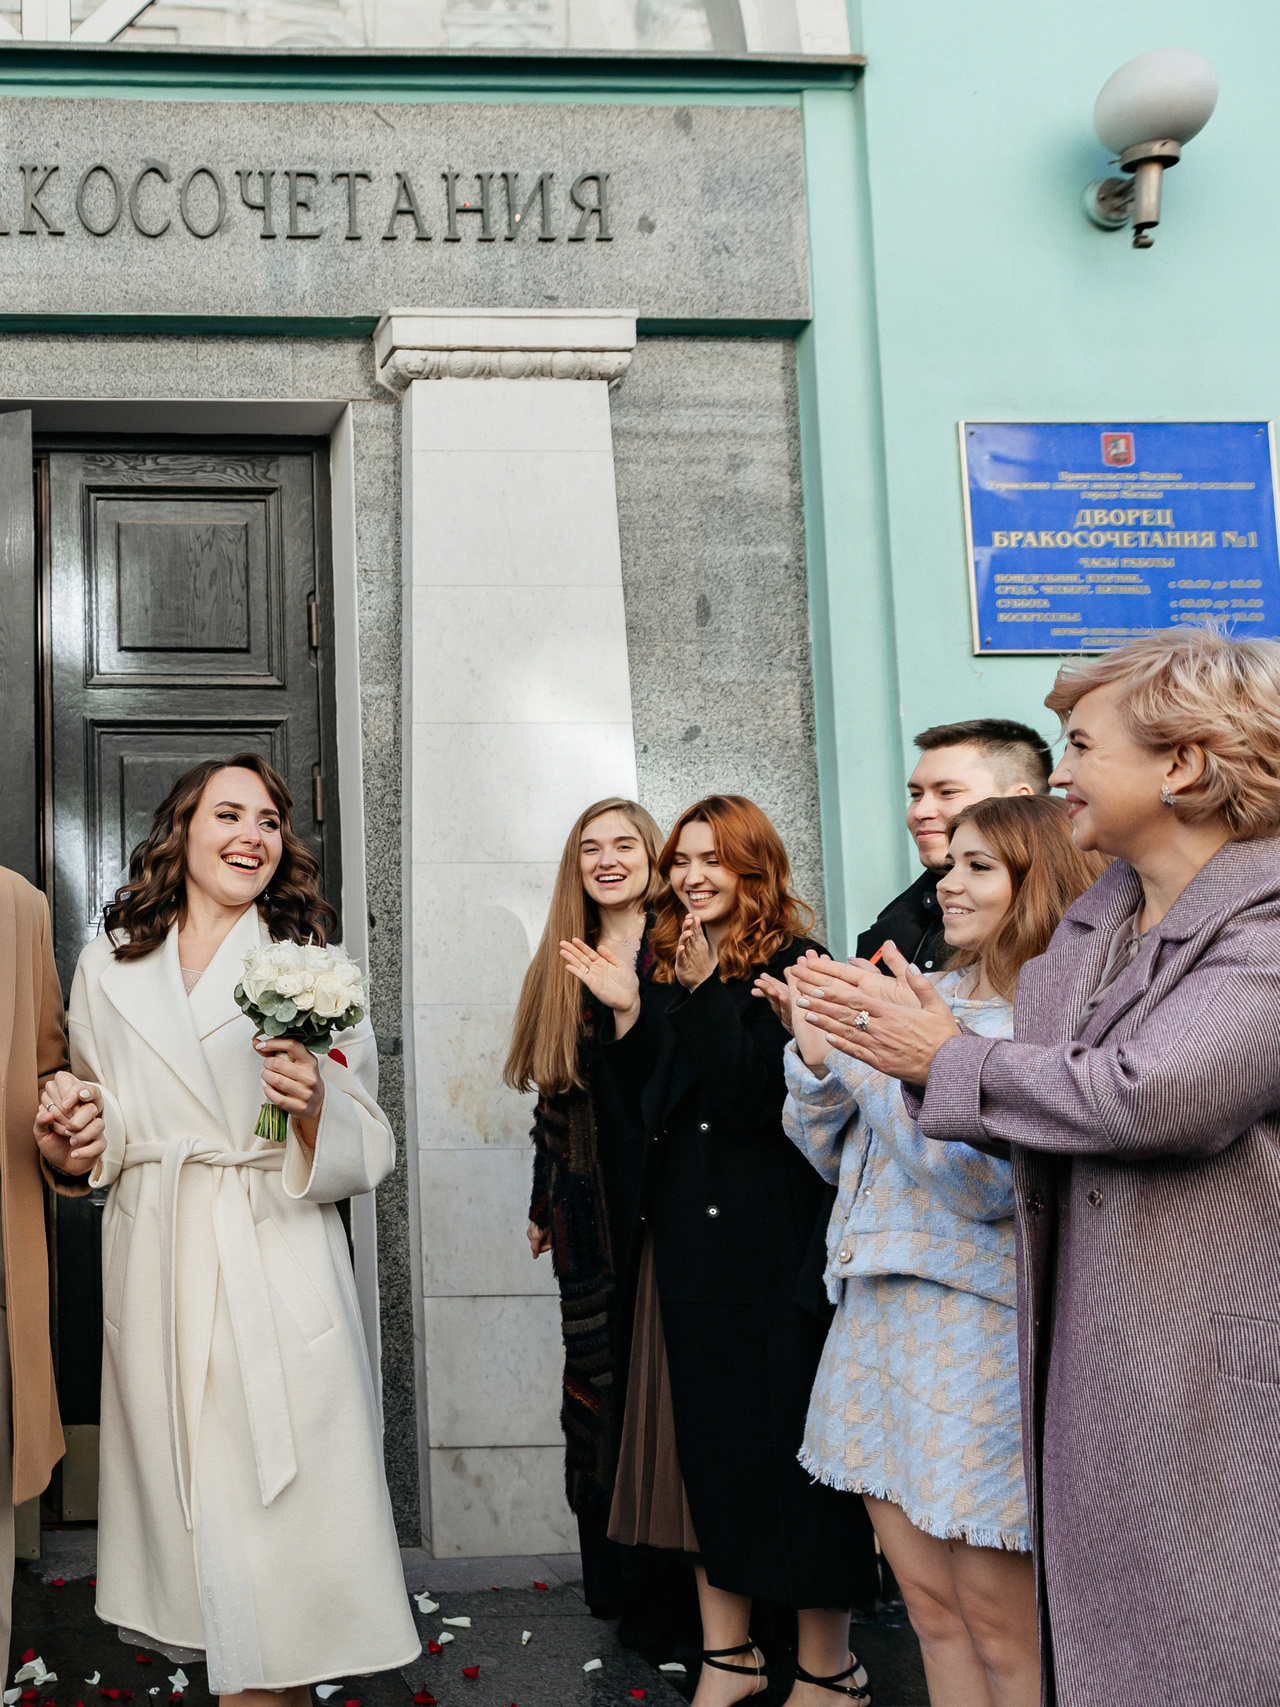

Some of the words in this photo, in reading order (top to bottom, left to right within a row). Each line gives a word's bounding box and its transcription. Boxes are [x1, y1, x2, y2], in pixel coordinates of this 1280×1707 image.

[1075, 509, 1174, 528] ДВОРЕЦ
[992, 531, 1216, 548] БРАКОСОЧЕТАНИЯ
[1222, 531, 1257, 548] №1
[1079, 558, 1119, 568] ЧАСЫ
[1120, 558, 1175, 568] РАБОТЫ
